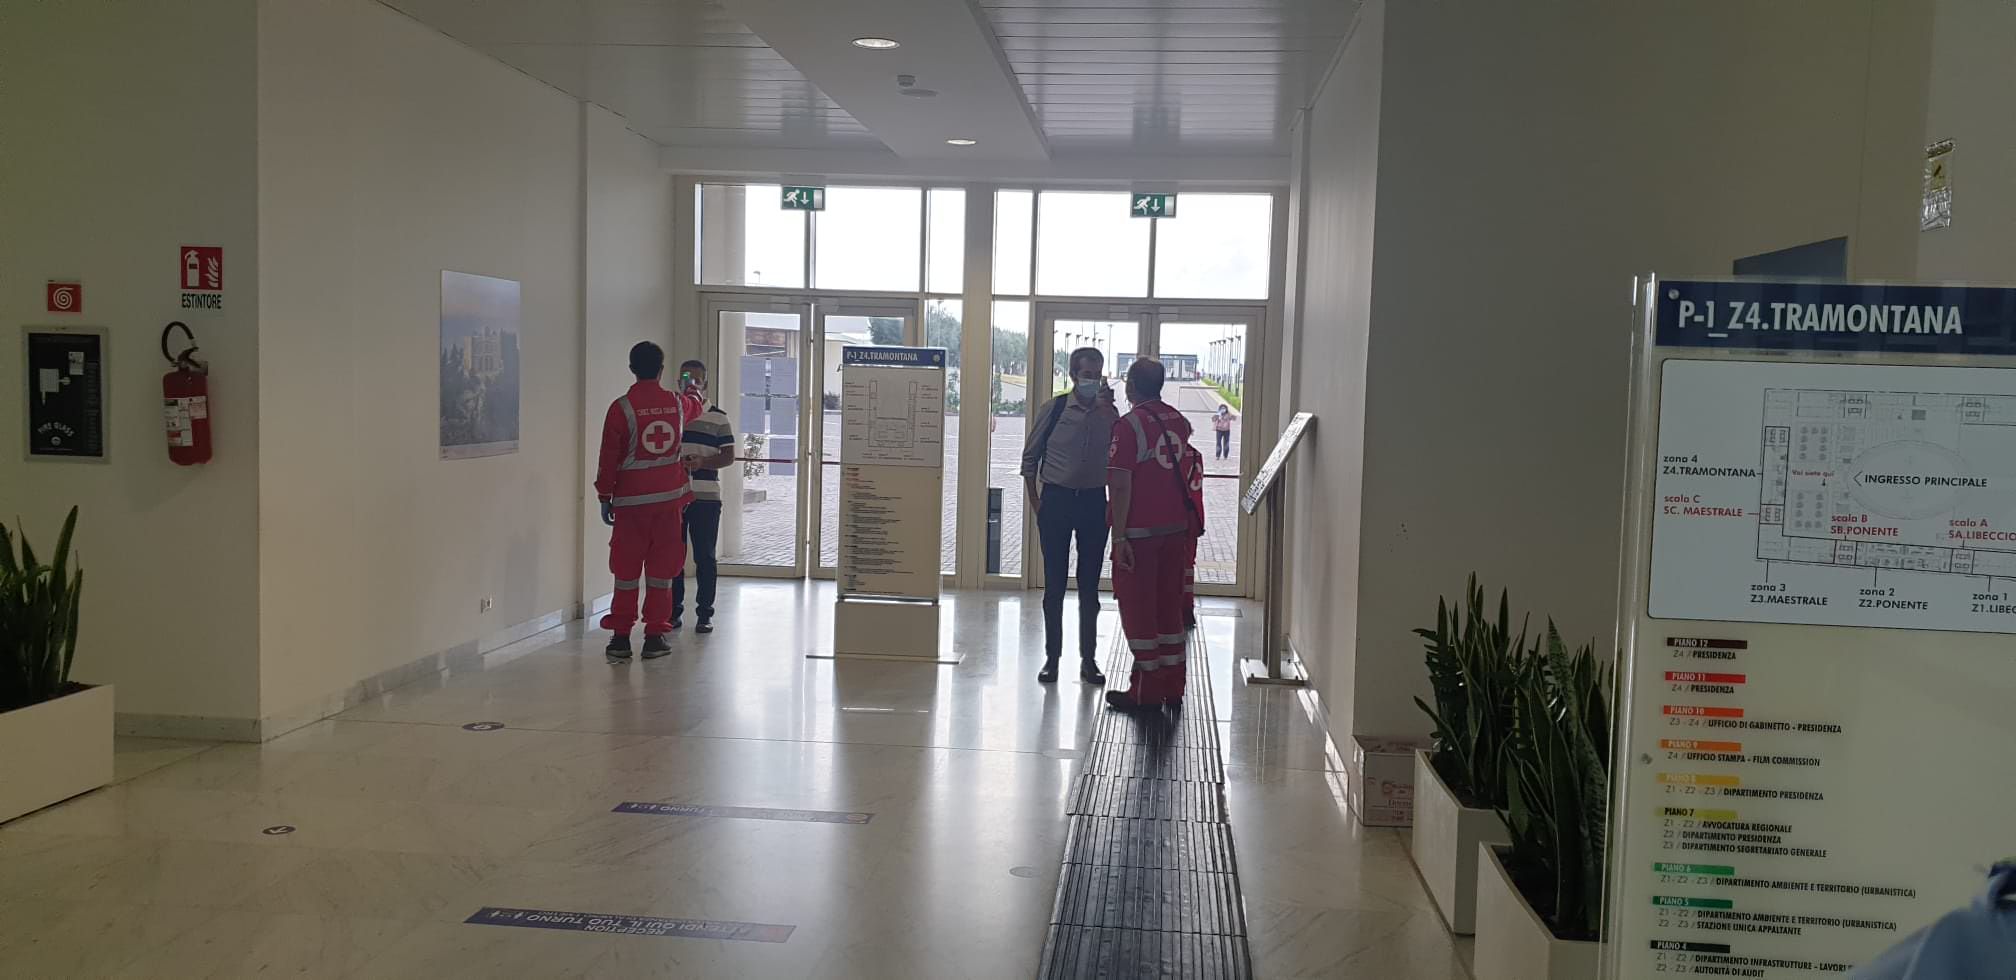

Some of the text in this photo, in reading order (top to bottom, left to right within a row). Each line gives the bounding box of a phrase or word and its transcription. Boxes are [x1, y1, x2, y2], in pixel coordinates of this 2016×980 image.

[181, 293, 222, 309] ESTINTORE
[1679, 301, 1963, 338] P-1_Z4.TRAMONTANA
[1663, 455, 1688, 463] zona
[1663, 466, 1756, 477] Z4.TRAMONTANA
[1865, 474, 1987, 487] INGRESSO PRINCIPALE
[1693, 495, 1700, 503] C
[1664, 506, 1743, 517] SC. MAESTRALE
[1832, 514, 1858, 523] scala
[1950, 518, 1988, 527] scala A
[1831, 526, 1898, 536] SB.PONENTE
[1889, 588, 1895, 596] 2
[1973, 593, 1999, 601] zona
[1751, 595, 1828, 605] Z3.MAESTRALE
[1859, 599, 1928, 609] Z2.PONENTE
[1674, 639, 1696, 647] PIANO
[1692, 651, 1736, 660] PRESIDENZA
[1698, 673, 1705, 681] 11
[1691, 685, 1734, 693] PRESIDENZA
[1670, 706, 1693, 714] PIANO
[1708, 720, 1737, 728] UFFICIO
[1750, 721, 1790, 731] GABINETTO
[1797, 724, 1841, 733] PRESIDENZA
[1687, 753, 1716, 761] UFFICIO
[1718, 754, 1745, 762] STAMPA
[1753, 756, 1770, 764] FILM
[1772, 756, 1820, 766] COMMISSION
[1724, 788, 1777, 798] DIPARTIMENTO
[1780, 791, 1823, 800] PRESIDENZA
[1665, 808, 1688, 816] PIANO
[1702, 821, 1749, 831] AVVOCATURA
[1752, 824, 1792, 833] REGIONALE
[1682, 831, 1735, 841] DIPARTIMENTO
[1738, 834, 1781, 843] PRESIDENZA
[1682, 842, 1735, 852] DIPARTIMENTO
[1737, 845, 1788, 855] SEGRETARIATO
[1791, 848, 1827, 858] GENERALE
[1716, 878, 1769, 888] DIPARTIMENTO
[1772, 881, 1808, 891] AMBIENTE
[1811, 883, 1814, 891] E
[1816, 883, 1859, 894] TERRITORIO
[1862, 886, 1916, 898] (URBANISTICA)
[527, 913, 585, 925] TURNO
[588, 917, 623, 927] TUO
[1698, 911, 1751, 921] DIPARTIMENTO
[1753, 914, 1790, 923] AMBIENTE
[1792, 916, 1796, 924] E
[1798, 916, 1840, 926] TERRITORIO
[1843, 919, 1896, 931] (URBANISTICA)
[645, 920, 675, 930] QUI
[1697, 921, 1731, 931] STAZIONE
[1733, 923, 1756, 932] UNICA
[1758, 925, 1801, 935] APPALTANTE
[583, 925, 667, 936] RECEPTION
[1658, 942, 1680, 950] PIANO
[1696, 955, 1748, 965] DIPARTIMENTO
[1750, 958, 1812, 970] INFRASTRUTTURE
[1742, 969, 1764, 978] AUDIT
